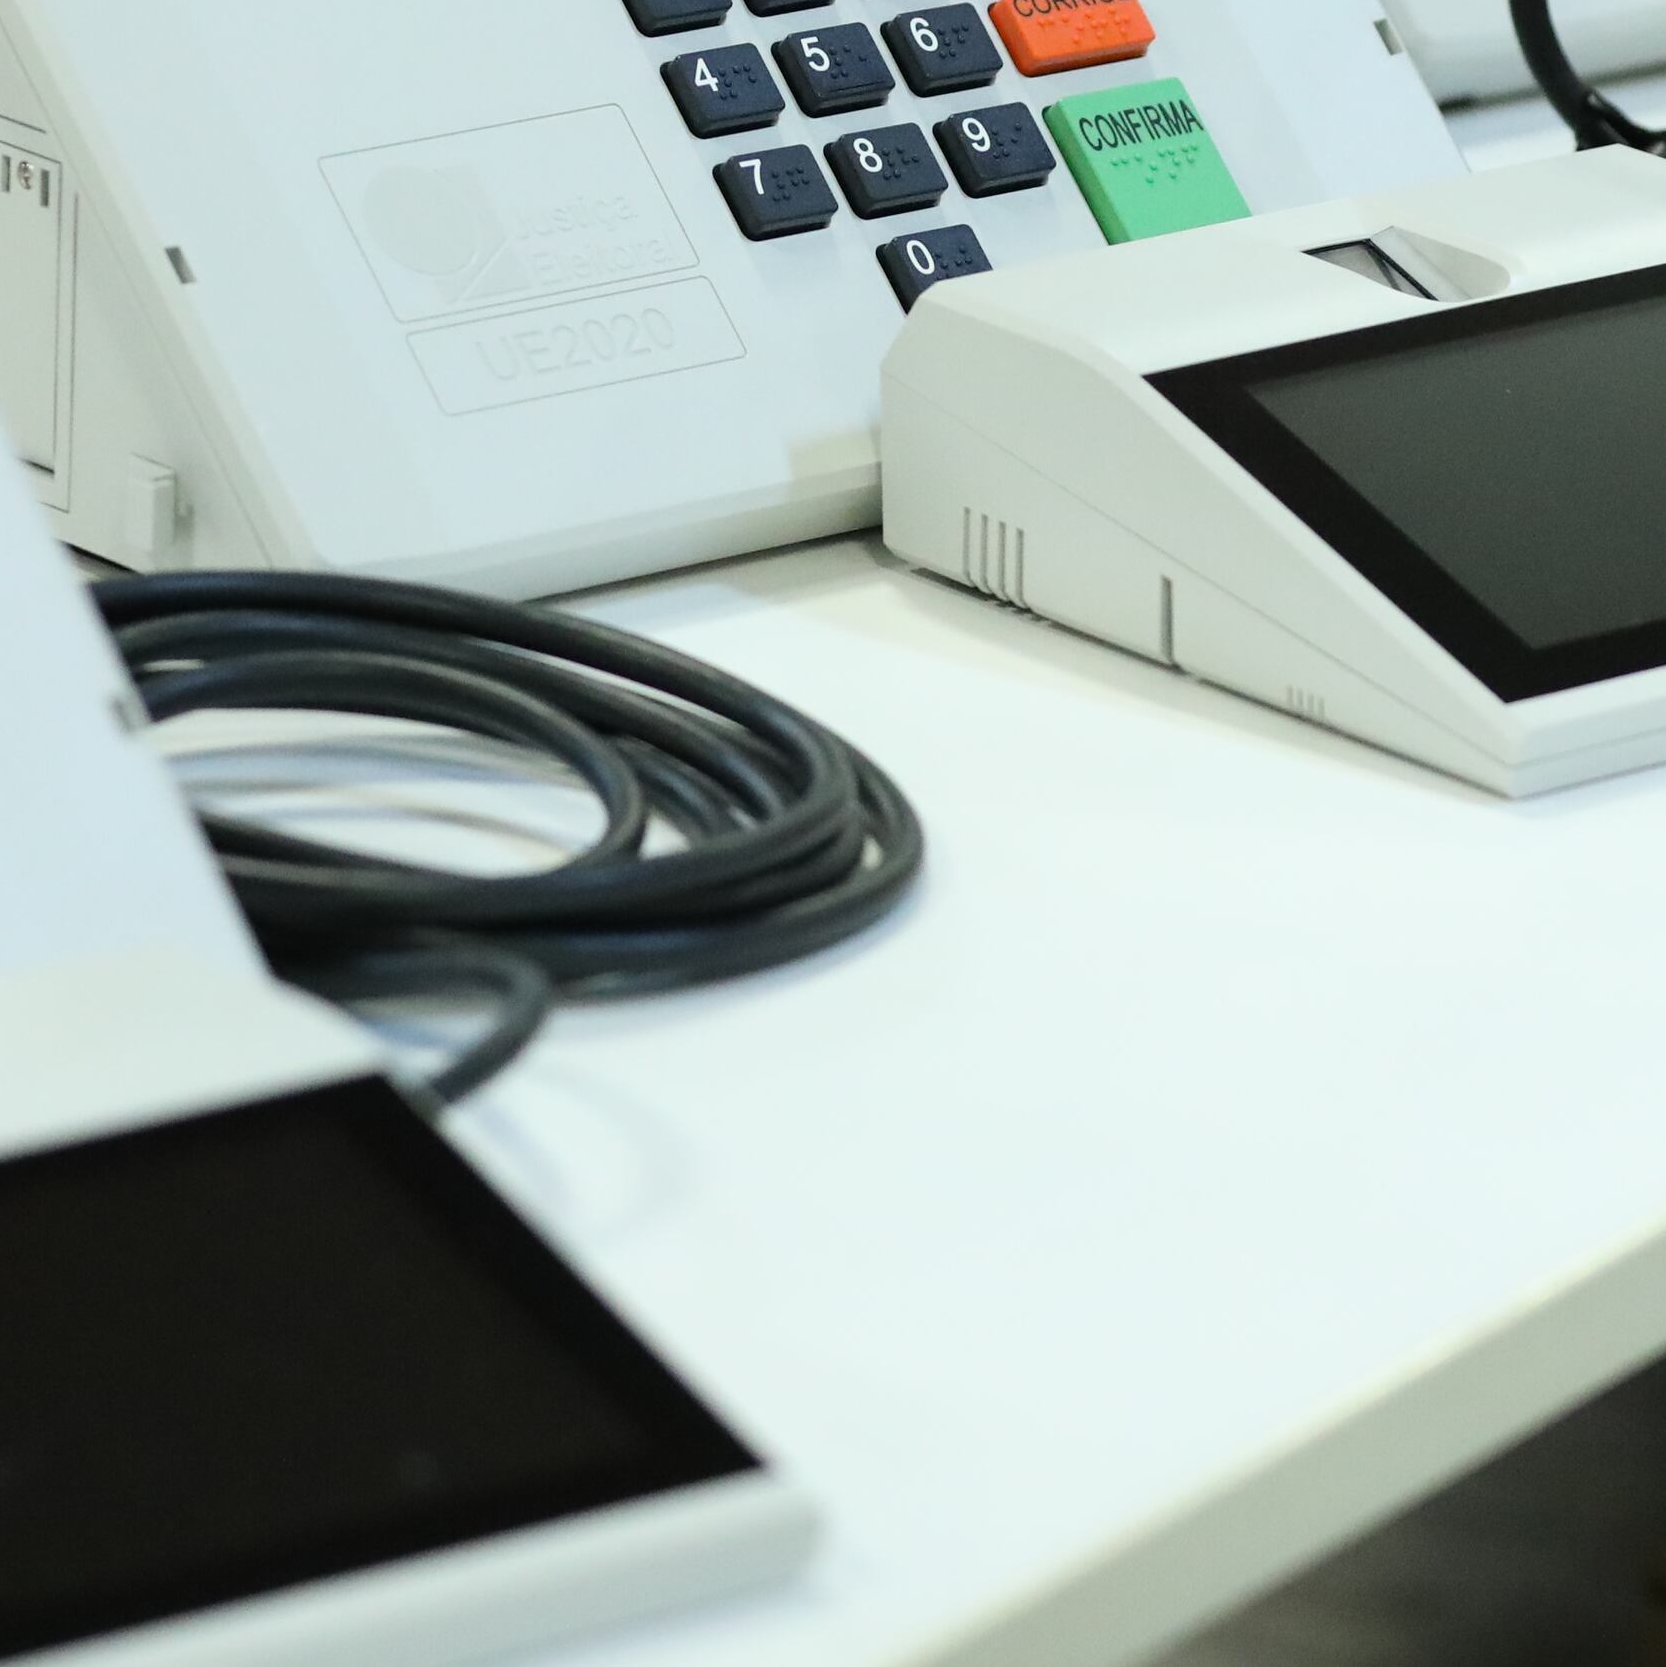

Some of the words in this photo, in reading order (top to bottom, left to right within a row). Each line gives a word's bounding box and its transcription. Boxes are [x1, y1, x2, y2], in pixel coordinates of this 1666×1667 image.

[909, 17, 939, 52] 6
[800, 36, 831, 72] 5
[693, 58, 719, 92] 4
[961, 117, 992, 152] 9
[1078, 99, 1205, 152] CONFIRMA
[853, 138, 883, 173] 8
[739, 158, 765, 195] 7
[906, 240, 935, 275] 0
[474, 306, 676, 383] UE2020
